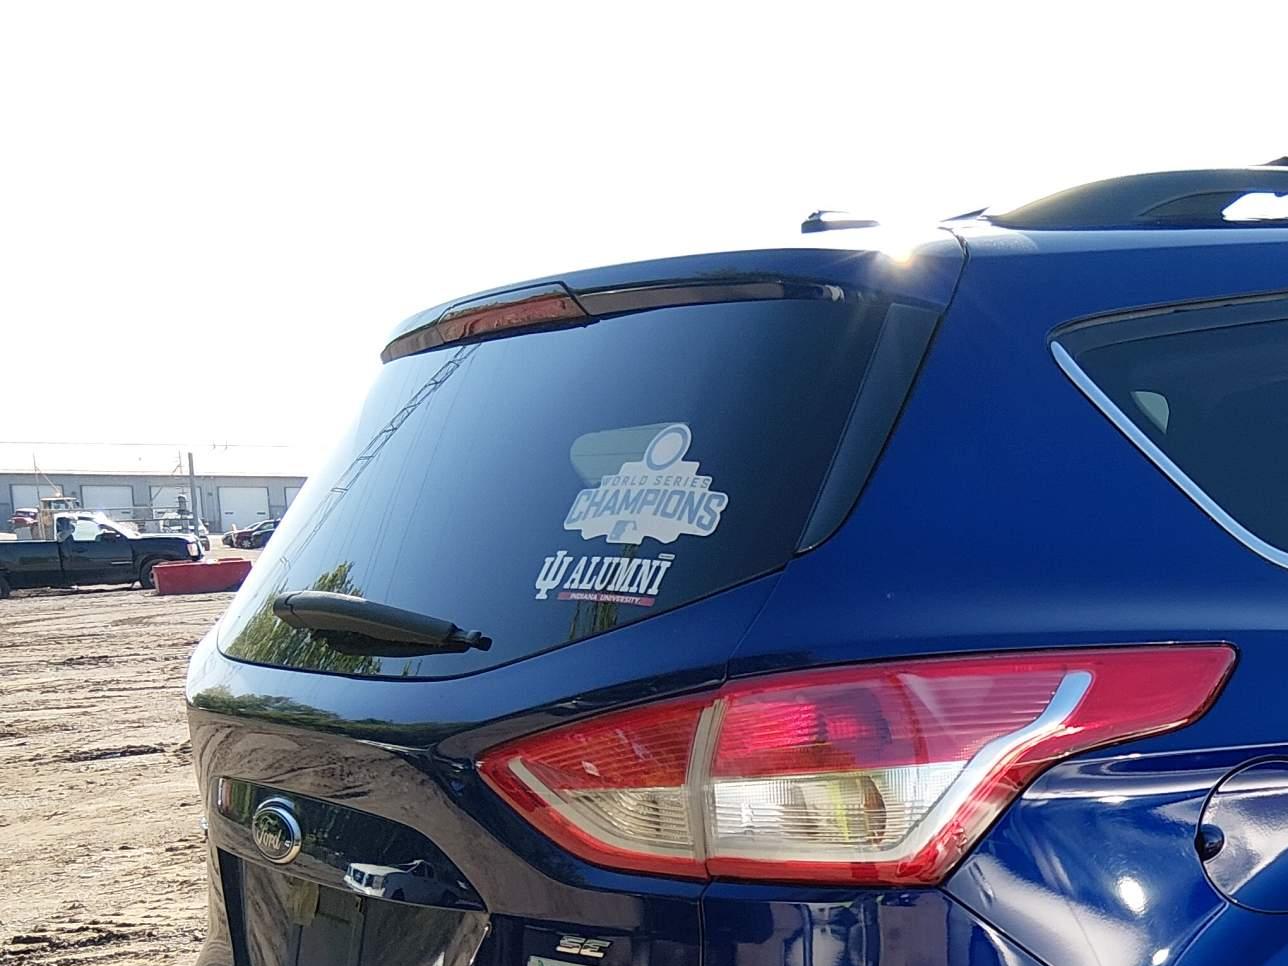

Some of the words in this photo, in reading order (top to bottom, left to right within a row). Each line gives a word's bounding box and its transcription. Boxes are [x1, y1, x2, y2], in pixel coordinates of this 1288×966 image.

[602, 475, 646, 487] WORLD
[653, 475, 711, 489] SERIES
[566, 489, 726, 530] CHAMPIONS
[563, 555, 674, 595] ALUMNI
[570, 592, 598, 600] INDIANA
[556, 935, 613, 958] SE
